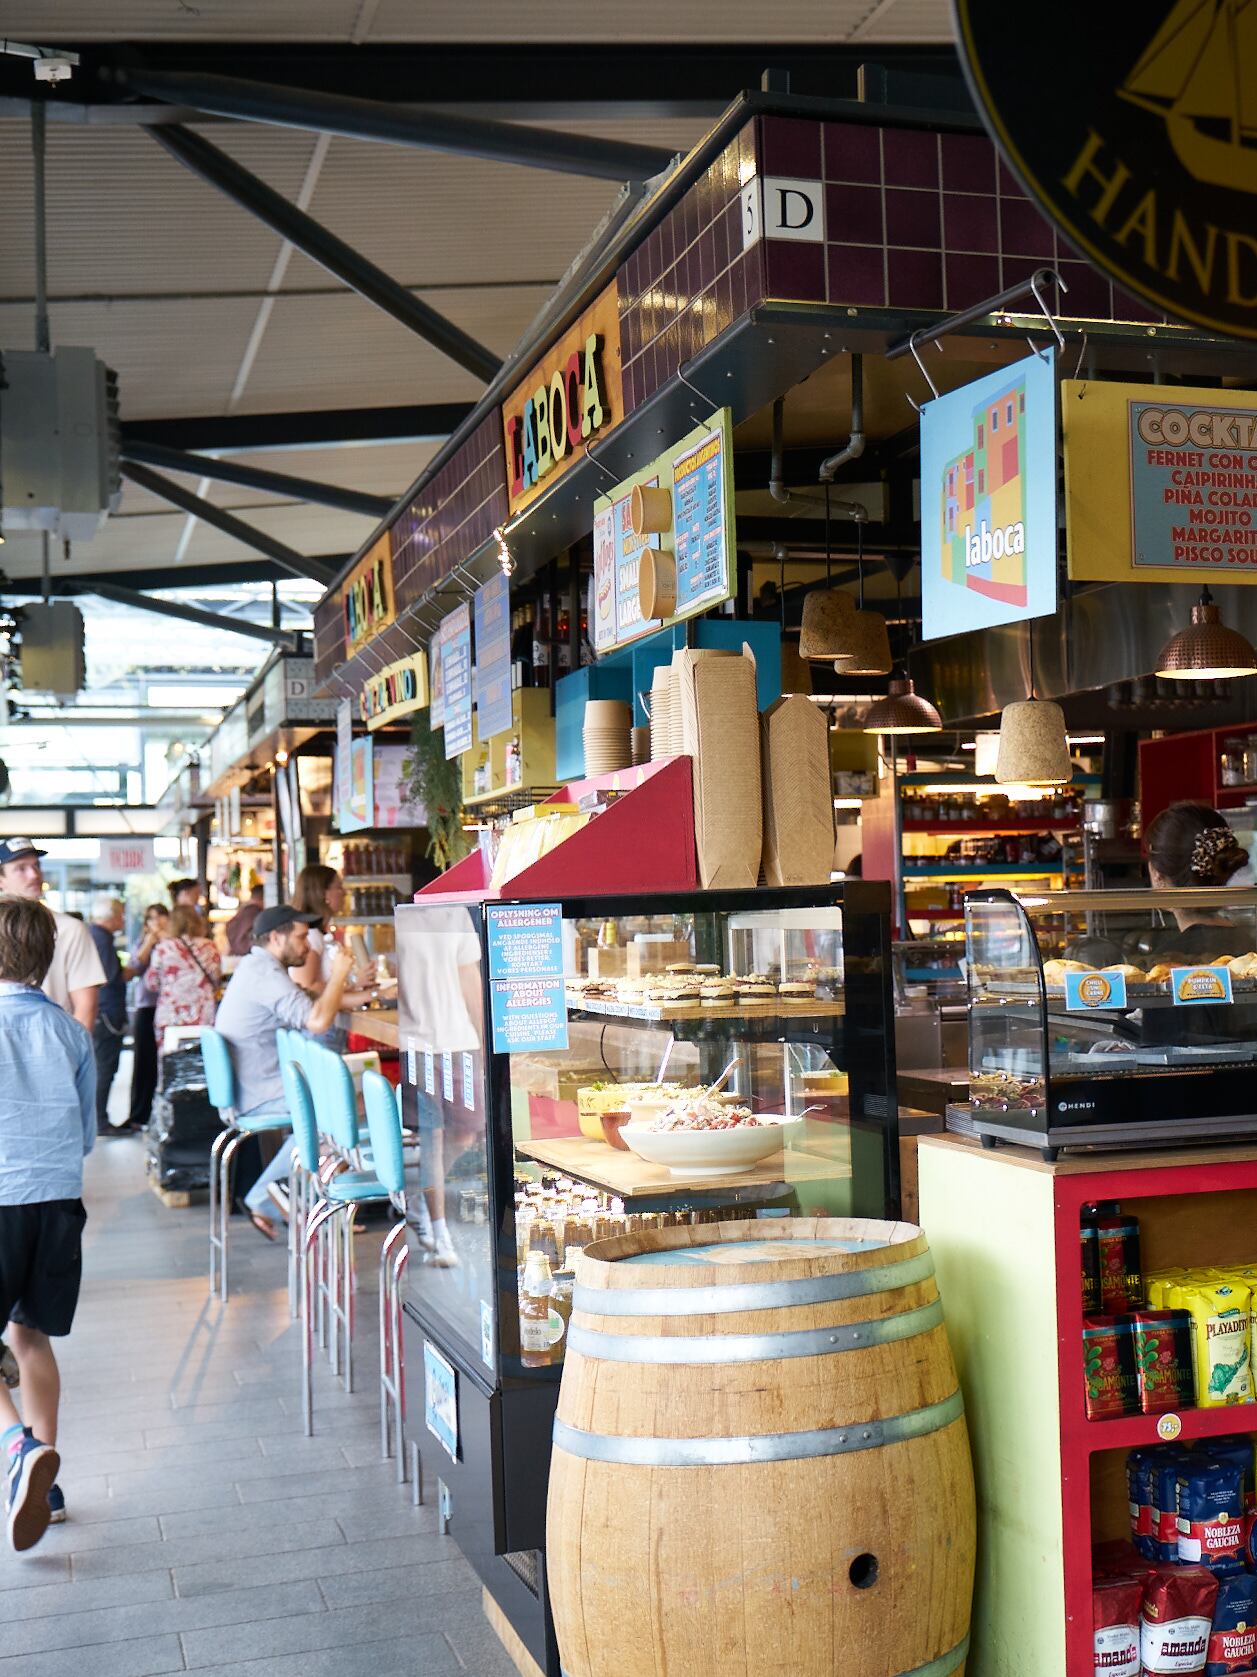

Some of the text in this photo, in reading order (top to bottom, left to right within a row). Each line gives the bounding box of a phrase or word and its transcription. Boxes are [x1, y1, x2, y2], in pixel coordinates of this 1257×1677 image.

[776, 189, 813, 228] D
[507, 334, 608, 498] LABOCA
[1147, 450, 1204, 467] FERNET
[1208, 454, 1243, 470] CON
[1164, 485, 1203, 505] PIÑA
[1190, 509, 1251, 526] MOJITO
[965, 520, 1025, 568] laboca
[1174, 546, 1223, 562] PISCO
[291, 682, 304, 695] D
[491, 909, 541, 918] OPLYSNING
[498, 919, 552, 927] ALLERGENER
[496, 981, 559, 991] INFORMATION
[513, 990, 544, 998] ABOUT
[506, 998, 551, 1007] ALLERGIES
[1207, 1319, 1249, 1340] PLAYADITO
[1205, 1525, 1240, 1538] NOBLEZA
[1206, 1535, 1239, 1548] GAUCHA
[1161, 1636, 1206, 1657] amanda
[1223, 1633, 1255, 1648] NOBLEZA
[1094, 1644, 1136, 1667] amanda
[1224, 1645, 1254, 1658] GAUCHA
